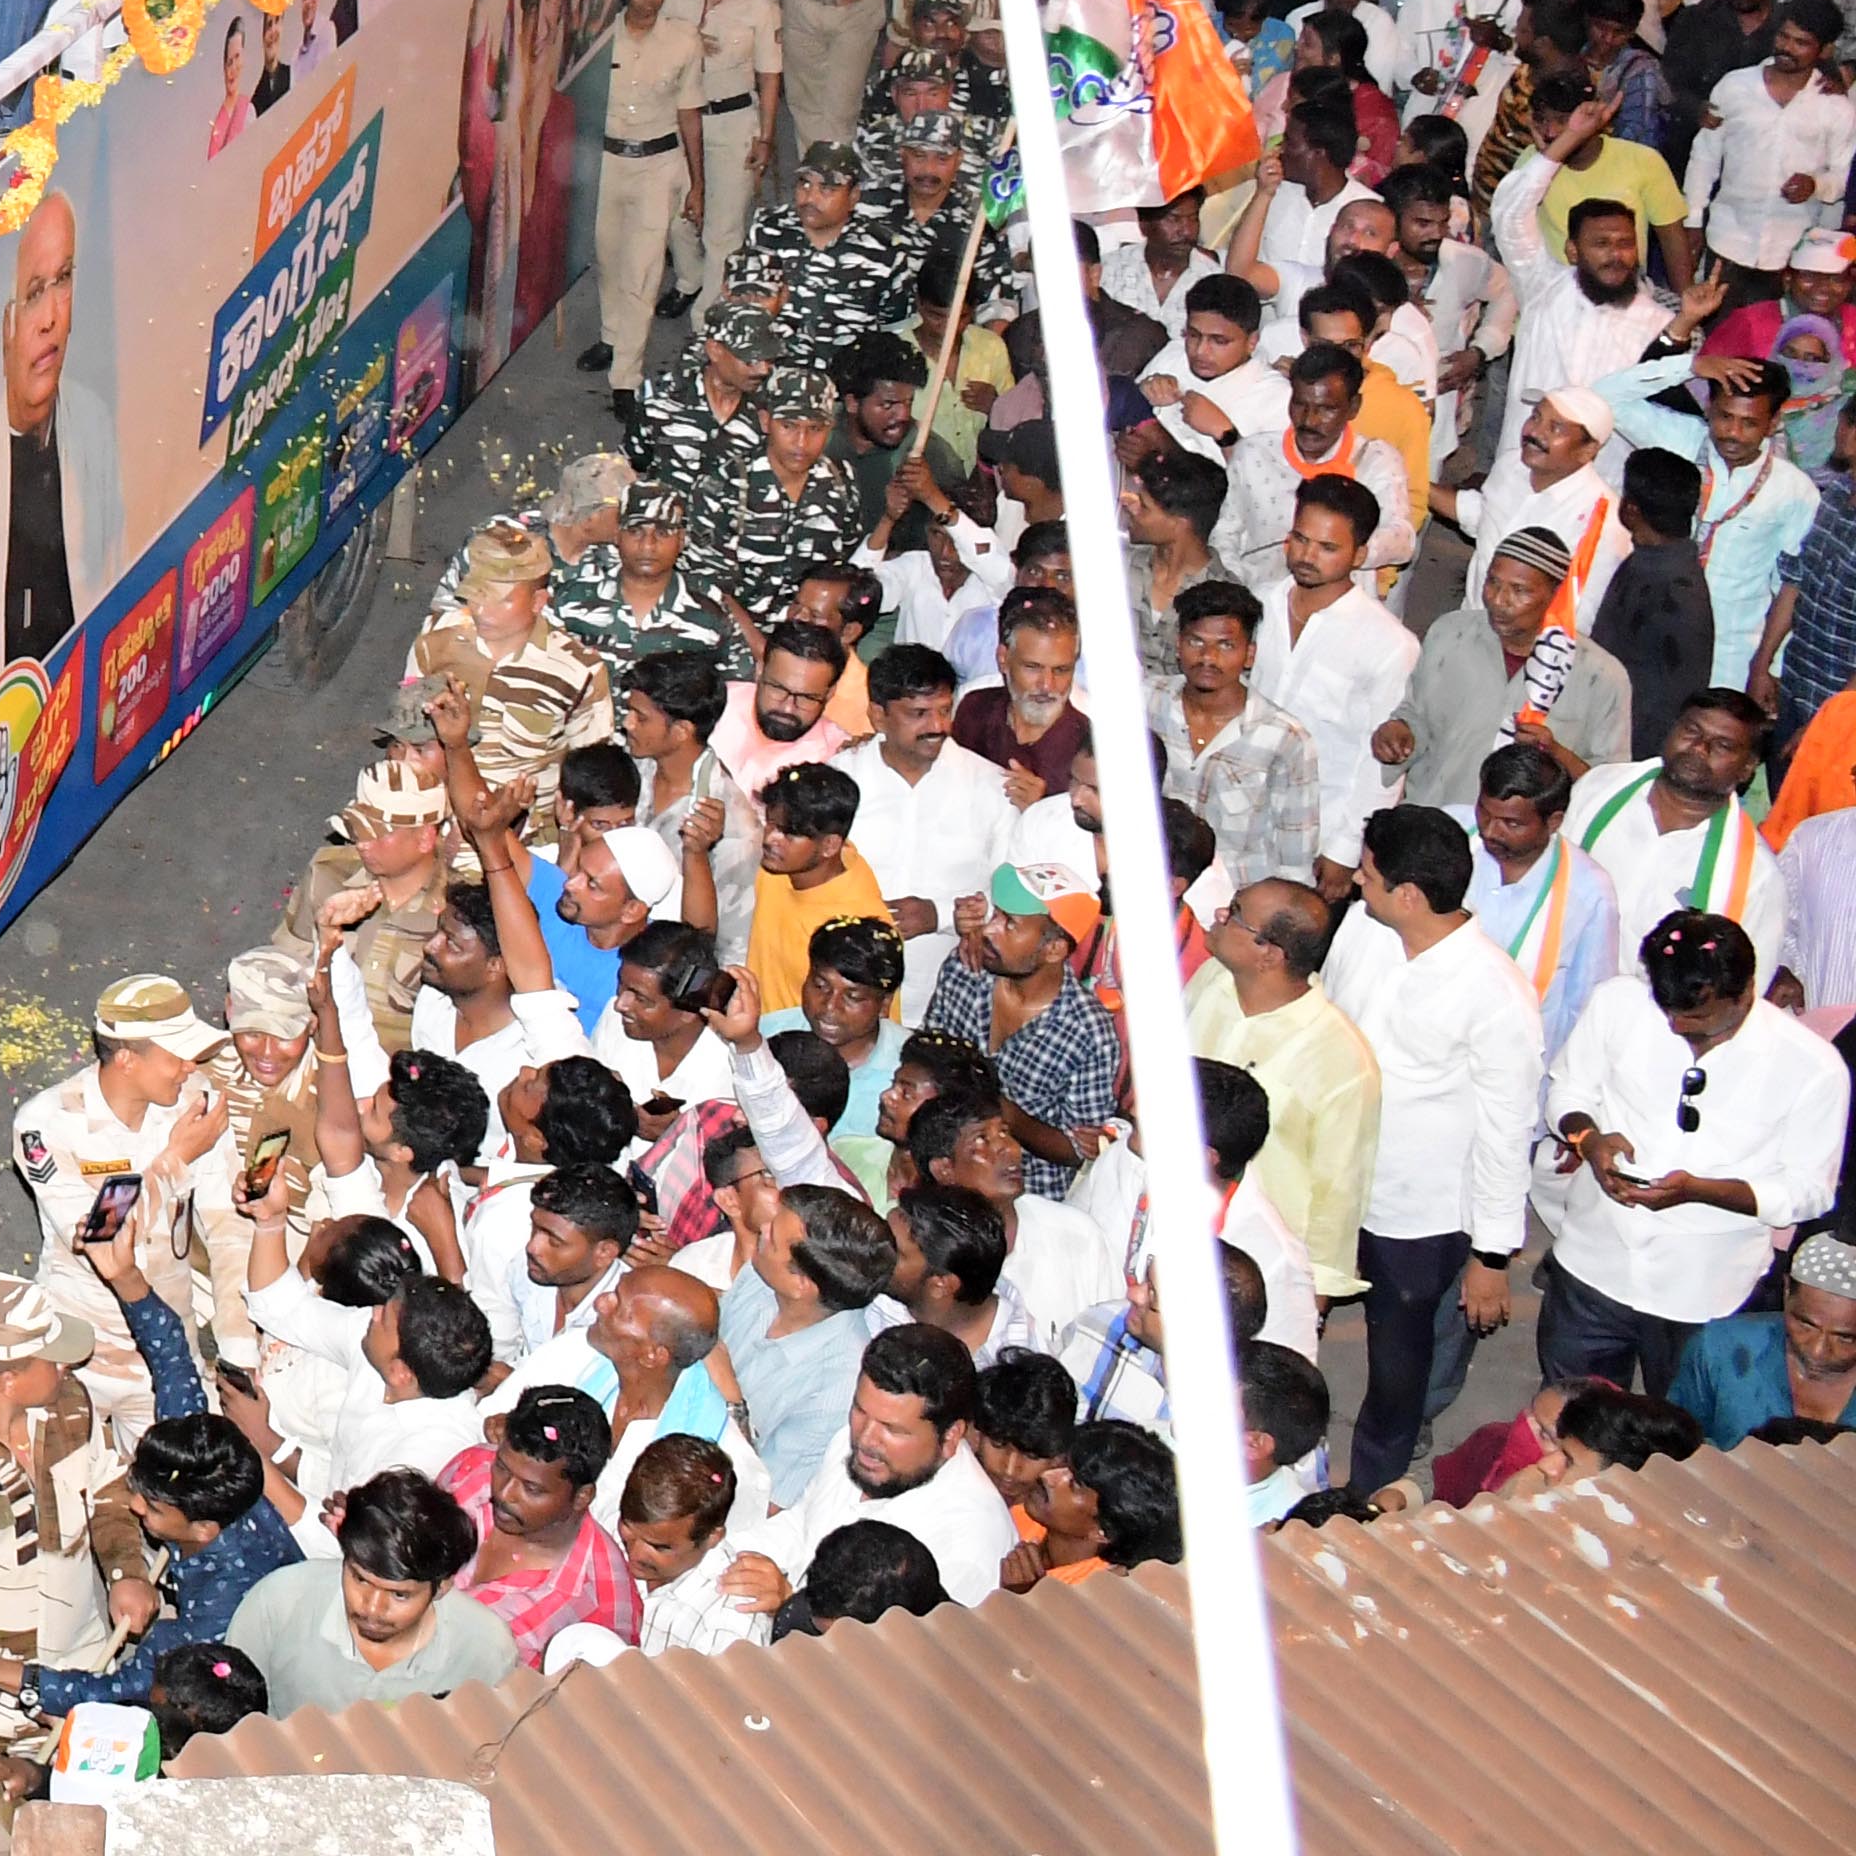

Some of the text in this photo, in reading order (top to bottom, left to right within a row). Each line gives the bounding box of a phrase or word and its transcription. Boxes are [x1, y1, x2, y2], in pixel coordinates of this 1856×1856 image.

[267, 87, 345, 232] ಬೃಹತ್
[215, 143, 369, 403] ಕಾಂಗ್ರೆಸ್
[199, 553, 241, 618] 2000
[118, 653, 148, 705] 200
